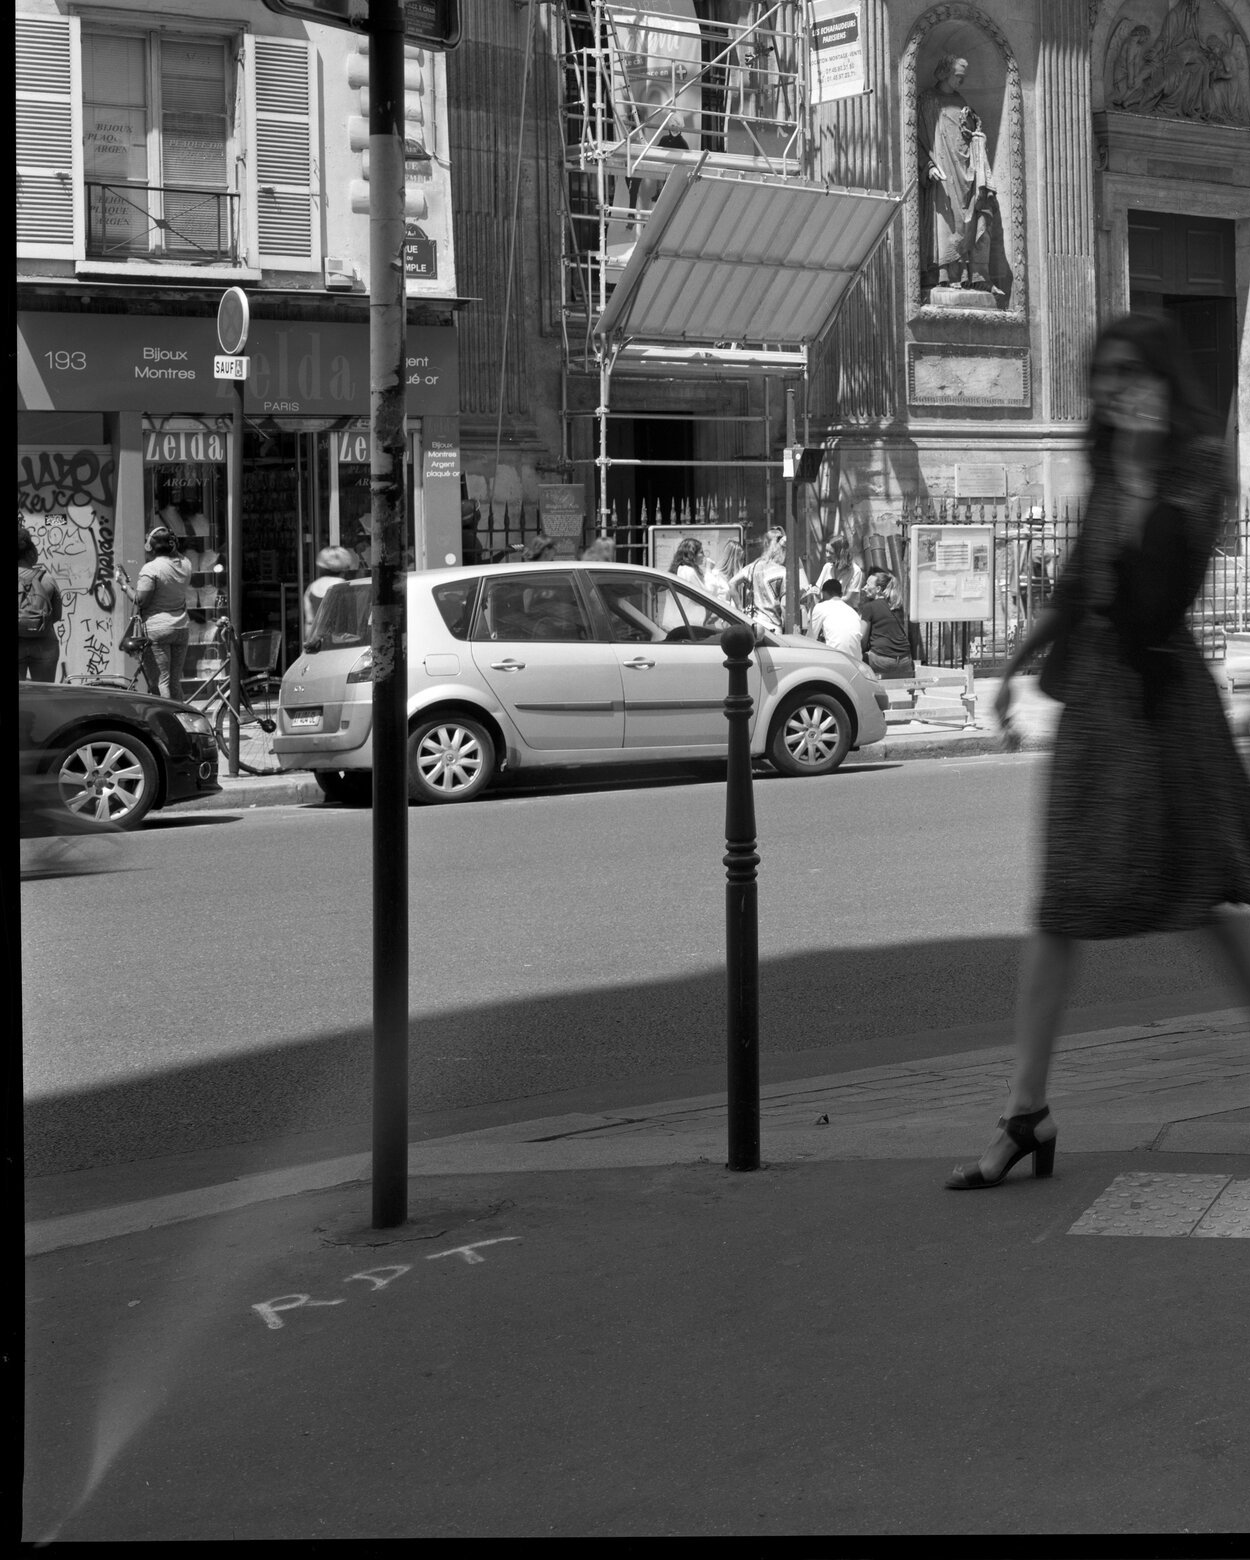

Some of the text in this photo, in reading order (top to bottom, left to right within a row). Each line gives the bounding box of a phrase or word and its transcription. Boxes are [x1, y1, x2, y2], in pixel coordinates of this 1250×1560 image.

[820, 19, 856, 35] ECHAFAUDEURS
[822, 31, 847, 44] PARISIENS
[405, 245, 418, 254] UE
[405, 263, 427, 273] MPLE
[44, 350, 87, 371] 193
[143, 347, 188, 362] Bijoux
[134, 366, 196, 380] Montres
[215, 361, 234, 375] SAUF
[263, 402, 300, 412] PARIS
[145, 432, 224, 461] Zelda
[431, 441, 453, 450] Bijoux
[431, 461, 455, 469] Argent
